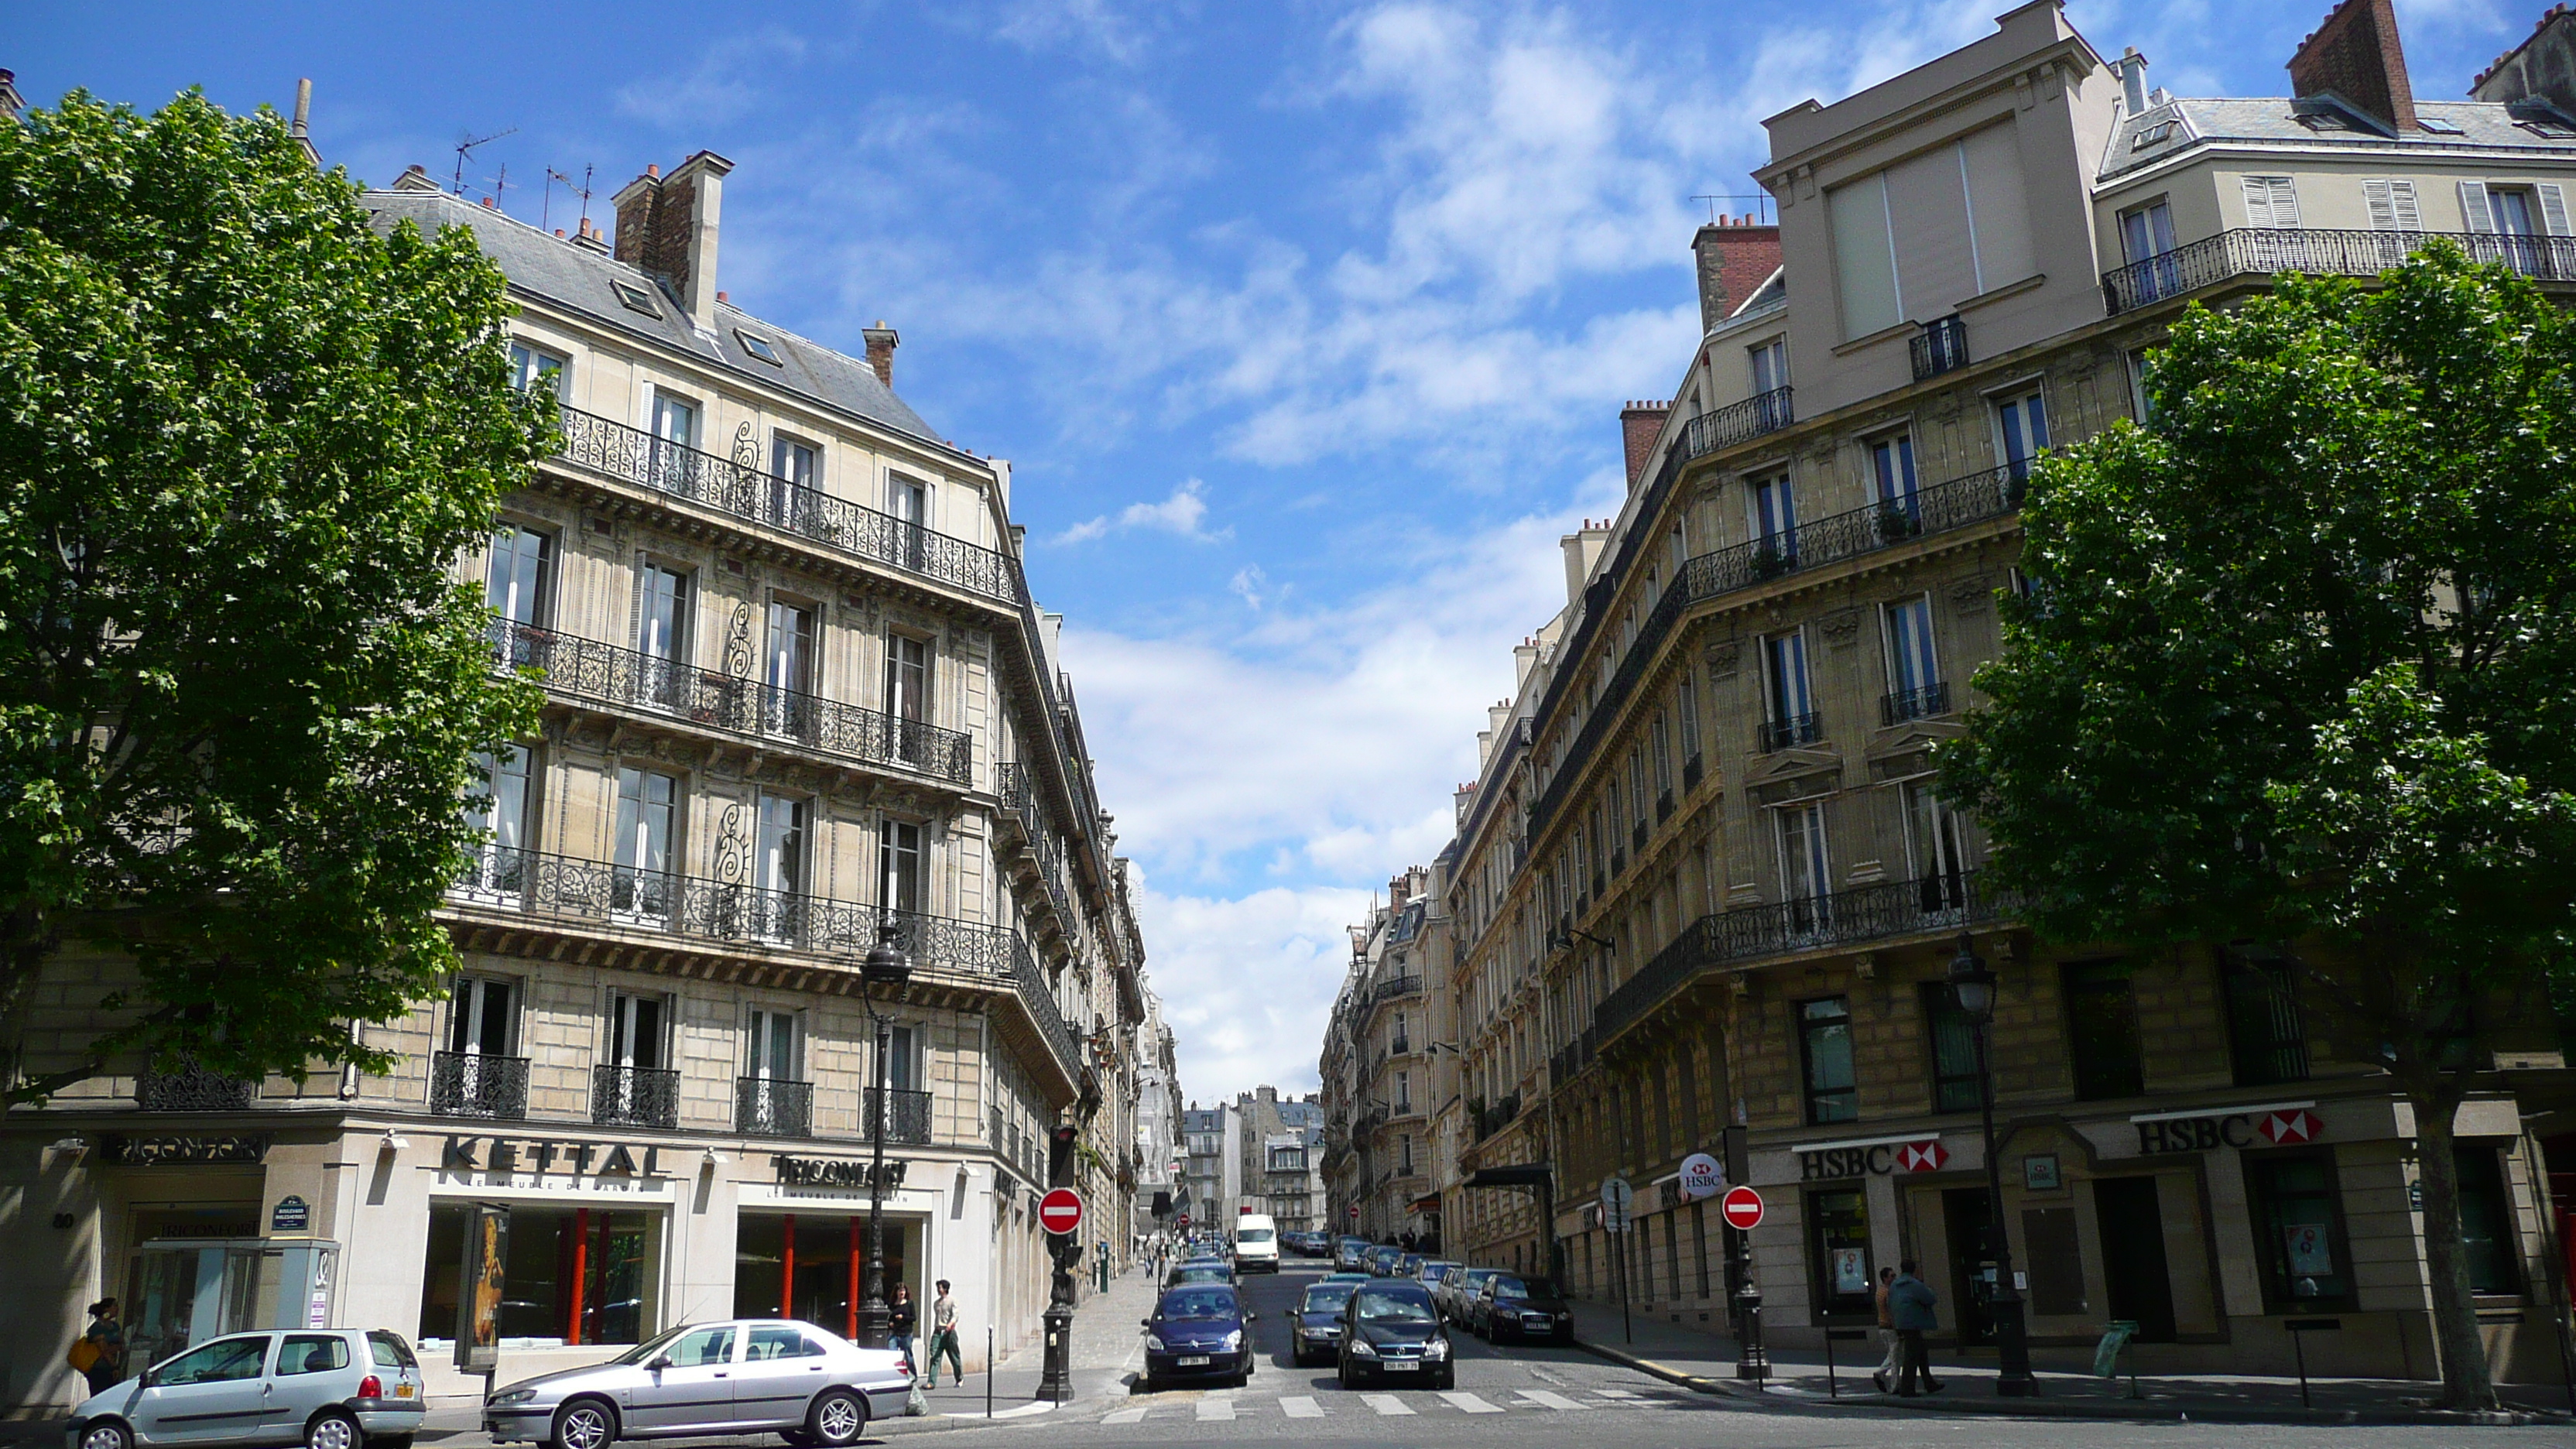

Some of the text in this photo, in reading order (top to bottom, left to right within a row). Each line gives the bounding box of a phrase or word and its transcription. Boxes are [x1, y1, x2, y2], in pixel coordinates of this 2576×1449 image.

[2135, 1115, 2253, 1154] HSBC
[447, 1135, 673, 1175] KETTAL
[1797, 1144, 1893, 1180] HSBC
[468, 1179, 482, 1187] LE
[497, 1180, 553, 1190] MEUBLE
[594, 1184, 644, 1193] JARDIN
[1686, 1175, 1720, 1188] HSBC
